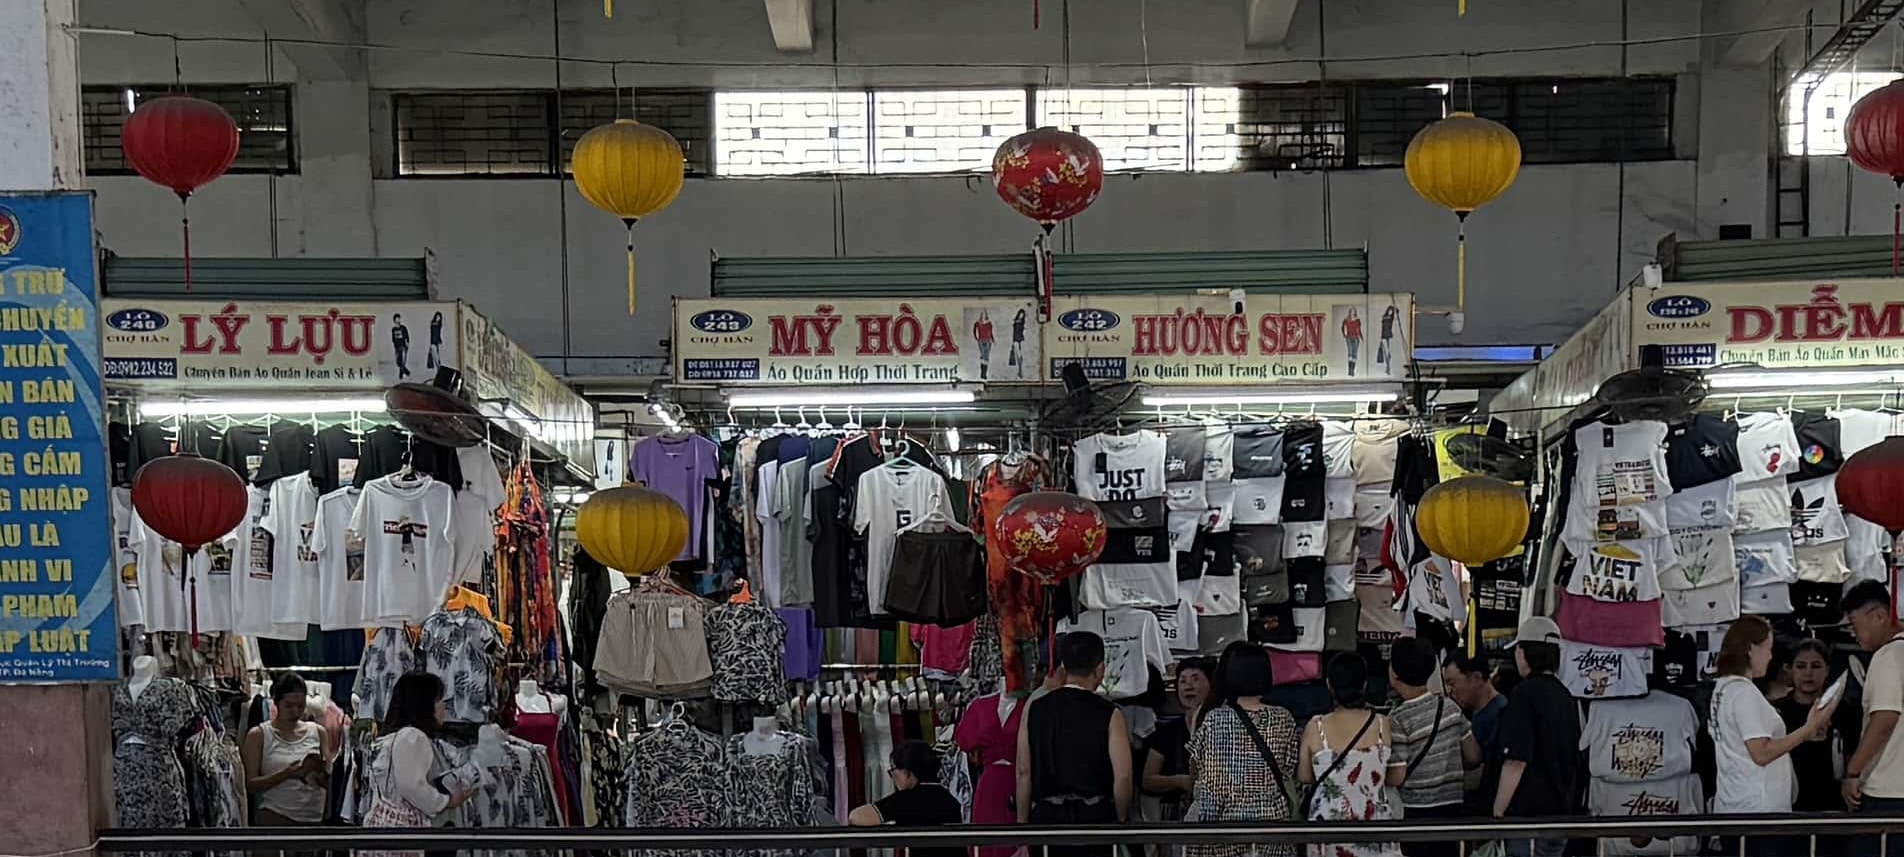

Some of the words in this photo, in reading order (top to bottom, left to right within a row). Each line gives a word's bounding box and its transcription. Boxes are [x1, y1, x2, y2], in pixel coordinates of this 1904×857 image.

[178, 303, 250, 355] LÝ
[767, 304, 843, 357] MỸ
[855, 302, 961, 357] HÒA
[1072, 320, 1108, 330] 242
[1132, 306, 1251, 357] HƯƠNG
[1258, 312, 1326, 356] SEN
[2, 335, 69, 368] XUẤT
[690, 336, 720, 345] CHỢ
[724, 335, 754, 344] HÀN
[184, 366, 225, 380] Chuyên
[304, 367, 331, 379] Jean
[792, 362, 833, 383] Quần
[912, 364, 960, 383] Trang
[1154, 362, 1190, 382] Quần
[1228, 364, 1267, 380] Trang
[1271, 364, 1297, 378] Cao
[22, 377, 76, 404] BÁN
[27, 410, 73, 439] GIẢ
[23, 444, 81, 476] CẤM
[1099, 468, 1145, 490] JUST
[20, 484, 90, 515] NHẬP
[29, 520, 61, 547] LÀ
[45, 558, 73, 582] VI
[1589, 555, 1642, 583] VIET
[1582, 576, 1640, 602] NAM
[29, 627, 92, 656] LUẬT
